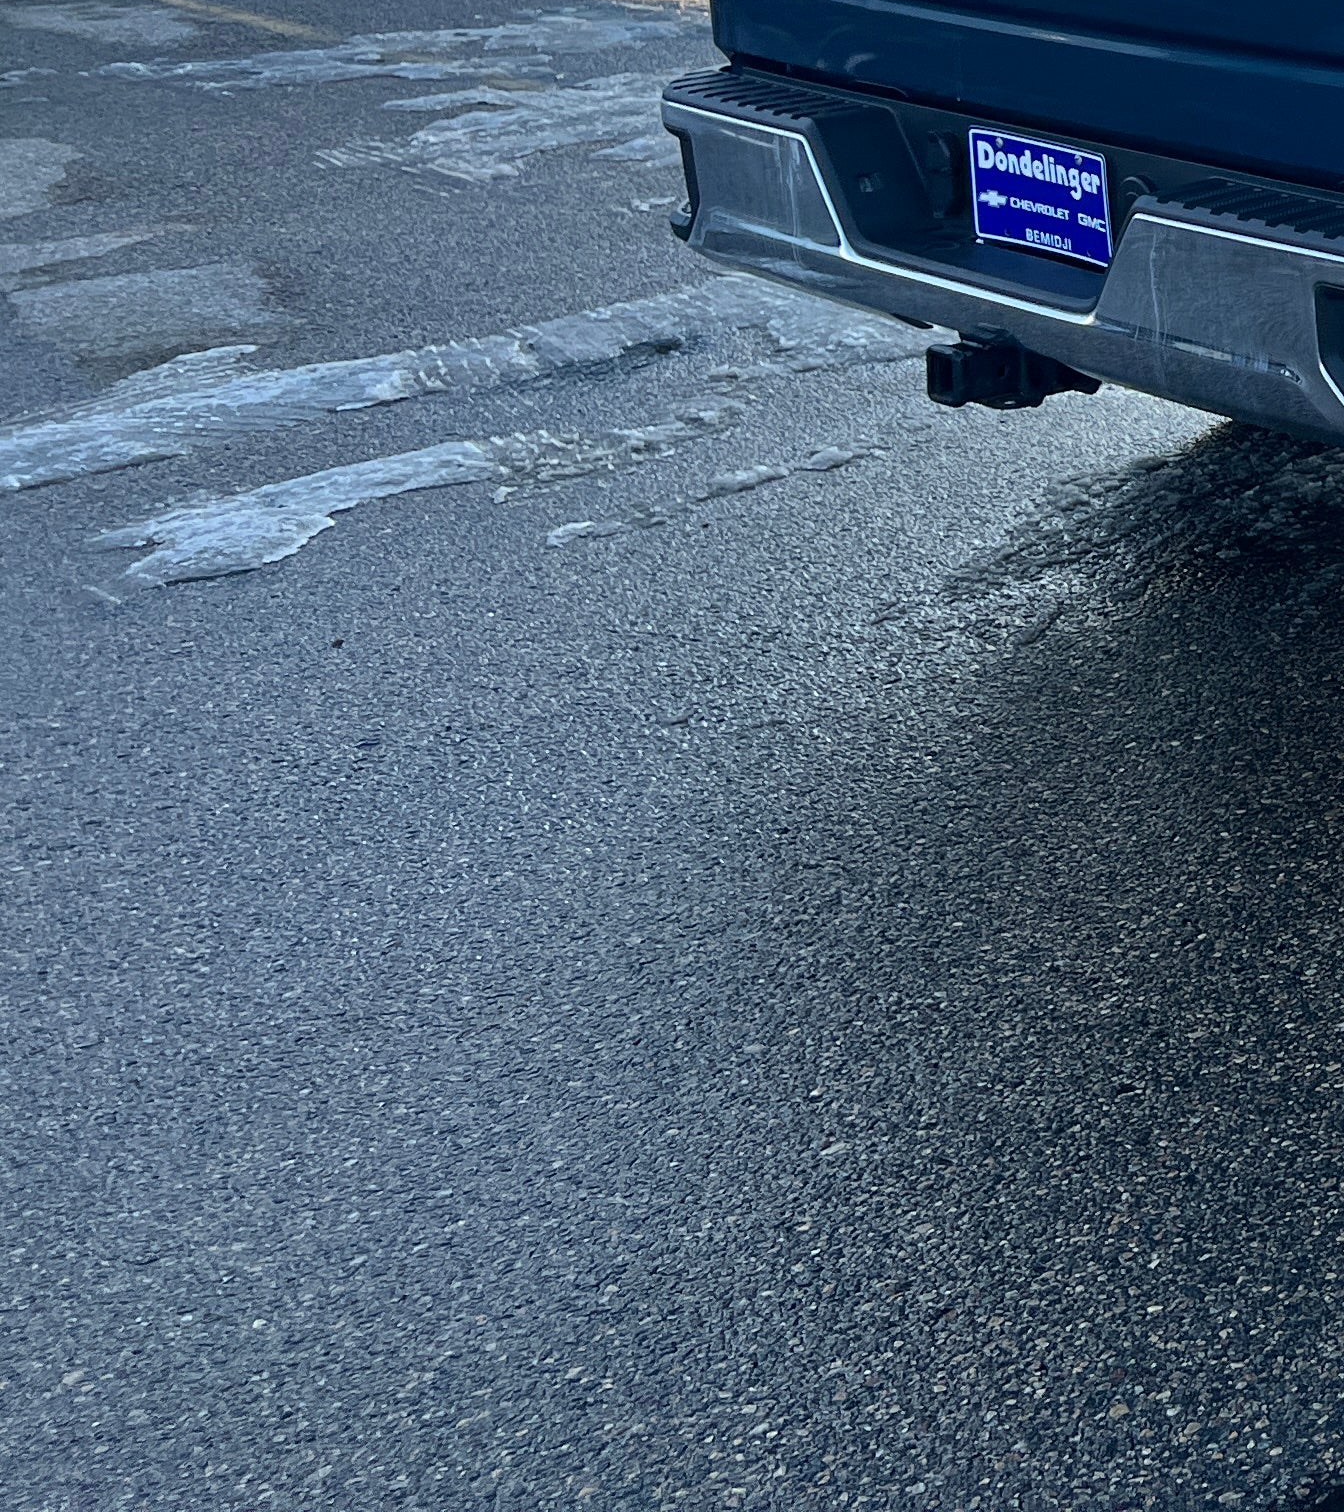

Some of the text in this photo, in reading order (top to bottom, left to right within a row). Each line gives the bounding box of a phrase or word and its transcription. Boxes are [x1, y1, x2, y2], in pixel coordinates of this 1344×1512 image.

[976, 139, 1101, 201] Dondelinger
[1009, 196, 1107, 233] CHEVROLET GMC
[1025, 227, 1073, 251] BEMIDJI
